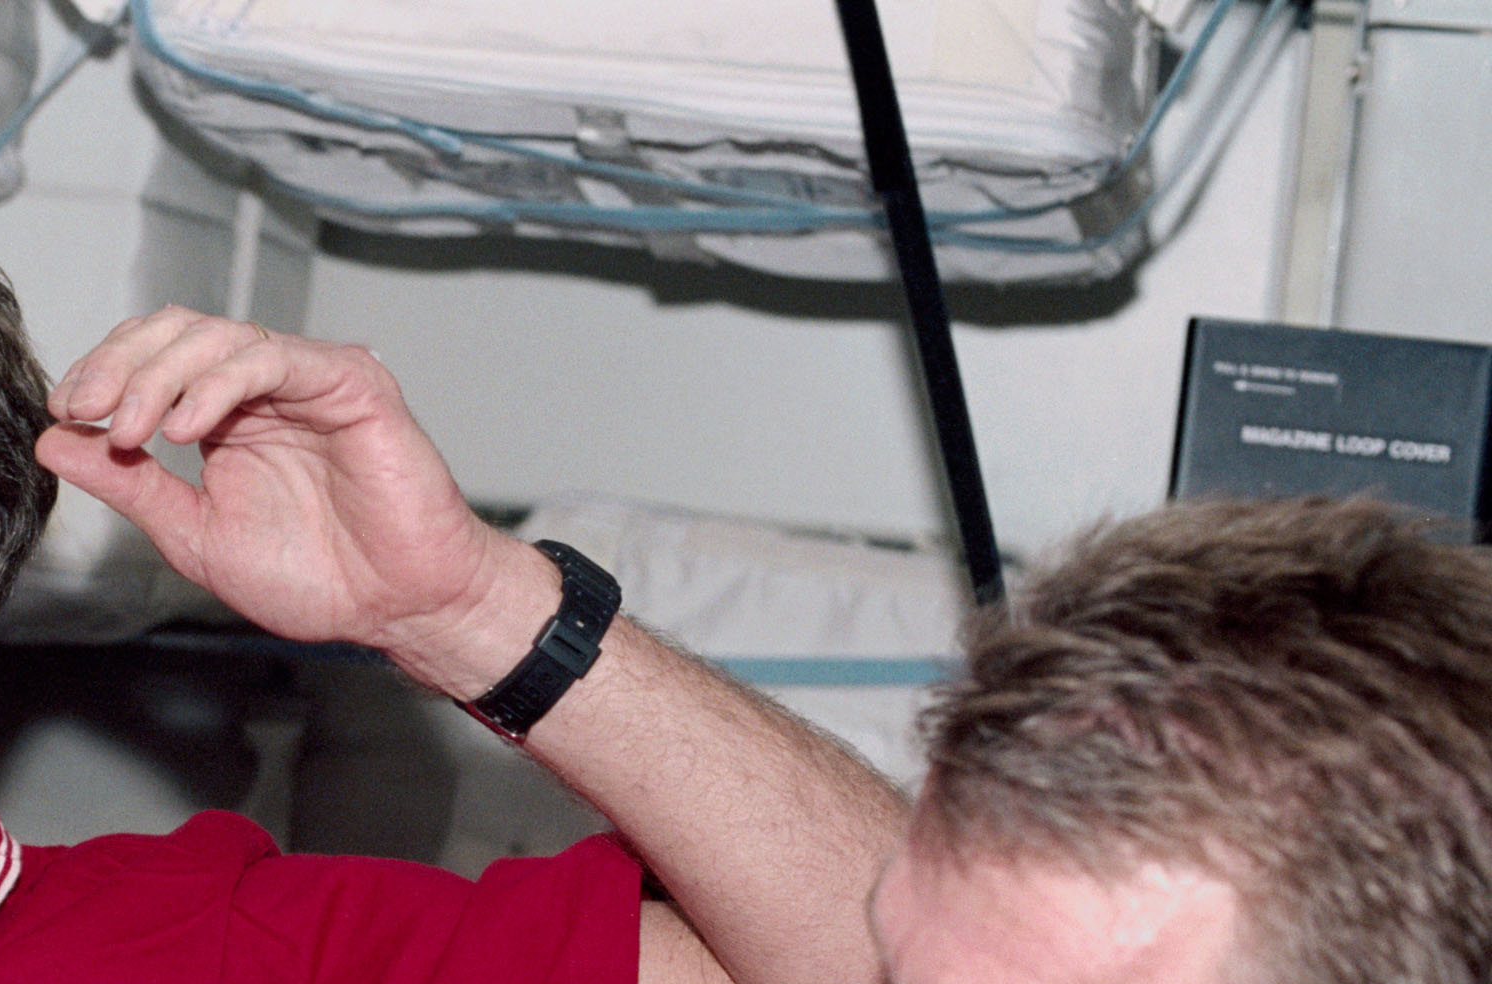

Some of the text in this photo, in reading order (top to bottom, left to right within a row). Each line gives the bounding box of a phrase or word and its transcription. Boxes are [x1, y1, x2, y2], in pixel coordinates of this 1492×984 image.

[1240, 425, 1451, 464] MAGAZINE LOOP COVER
